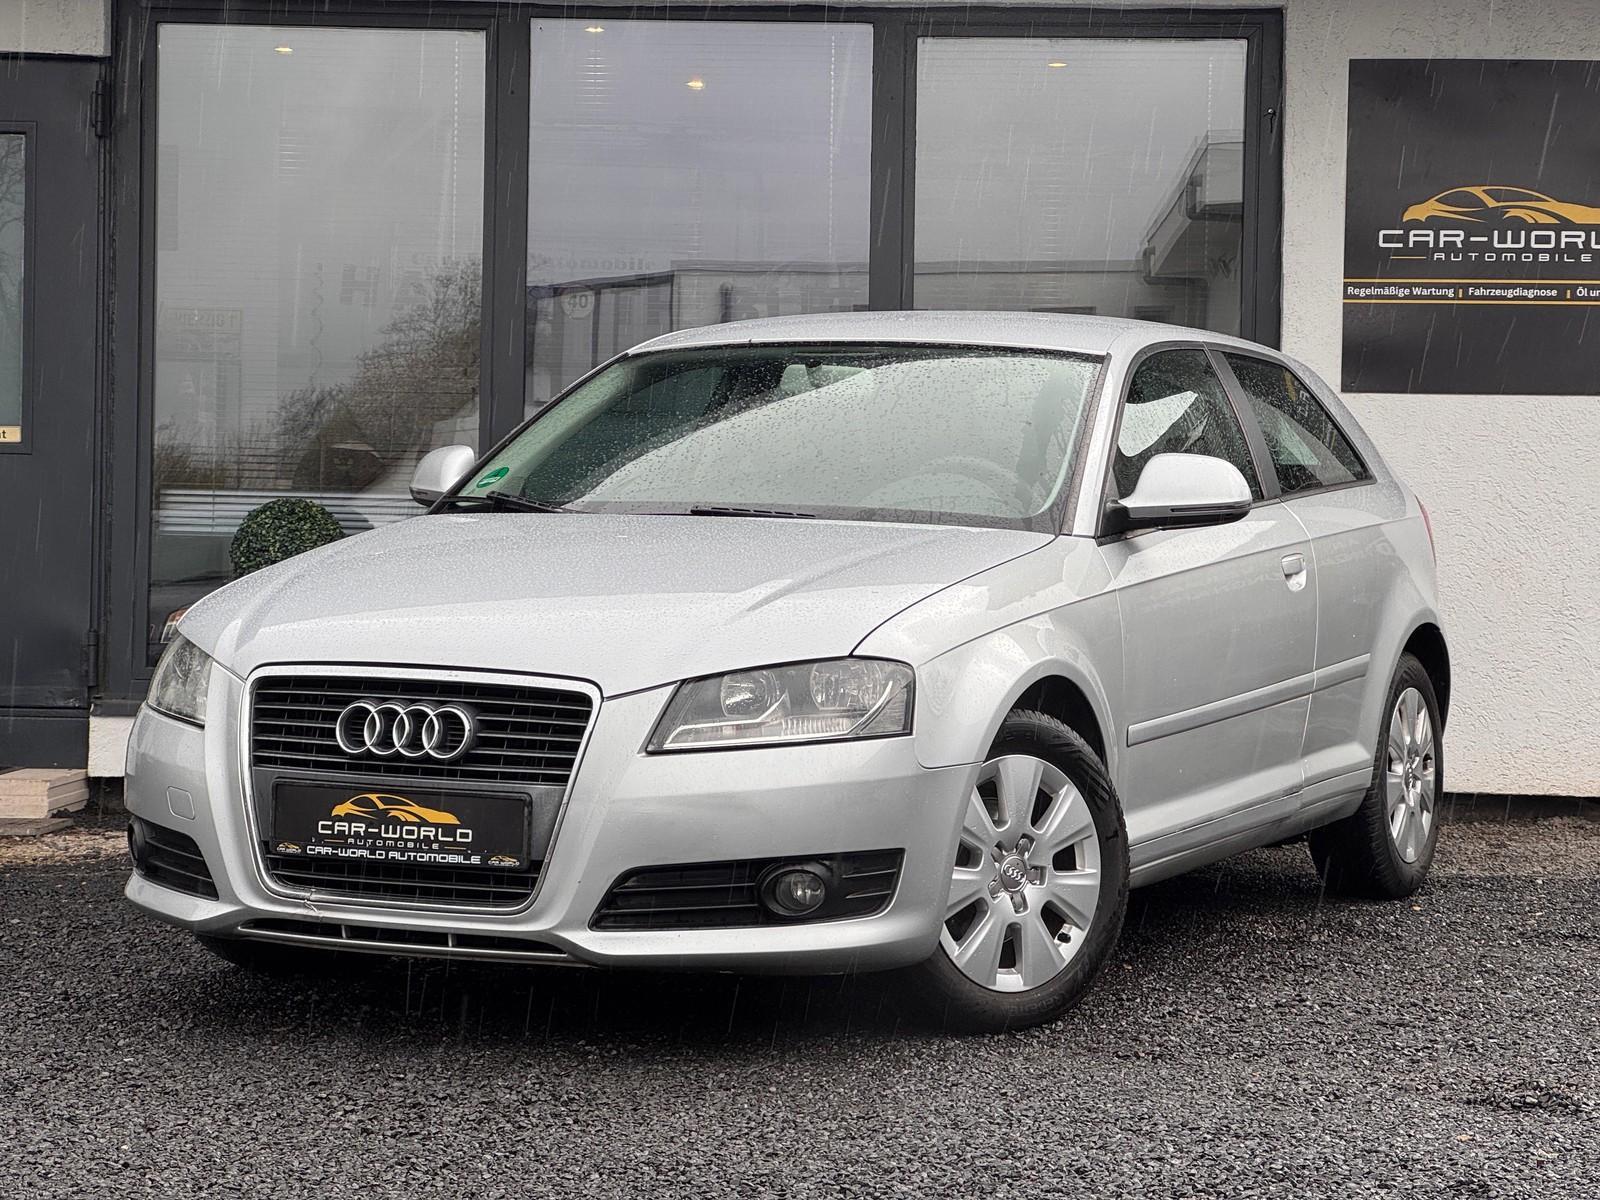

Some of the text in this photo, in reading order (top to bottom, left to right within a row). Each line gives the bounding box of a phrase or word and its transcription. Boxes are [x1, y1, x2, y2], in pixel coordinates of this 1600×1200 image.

[1433, 252, 1593, 262] AUTOMOBILE
[1347, 286, 1410, 297] Regelmäßige
[1412, 286, 1454, 298] Wartung
[1468, 287, 1558, 298] Fahrzeugdiagnose
[1576, 286, 1588, 297] Öl
[317, 821, 473, 842] CAR-WORLD
[347, 838, 440, 850] AUTOMOBILE
[306, 845, 481, 865] CAR-WORLD AUTOMOBILE
